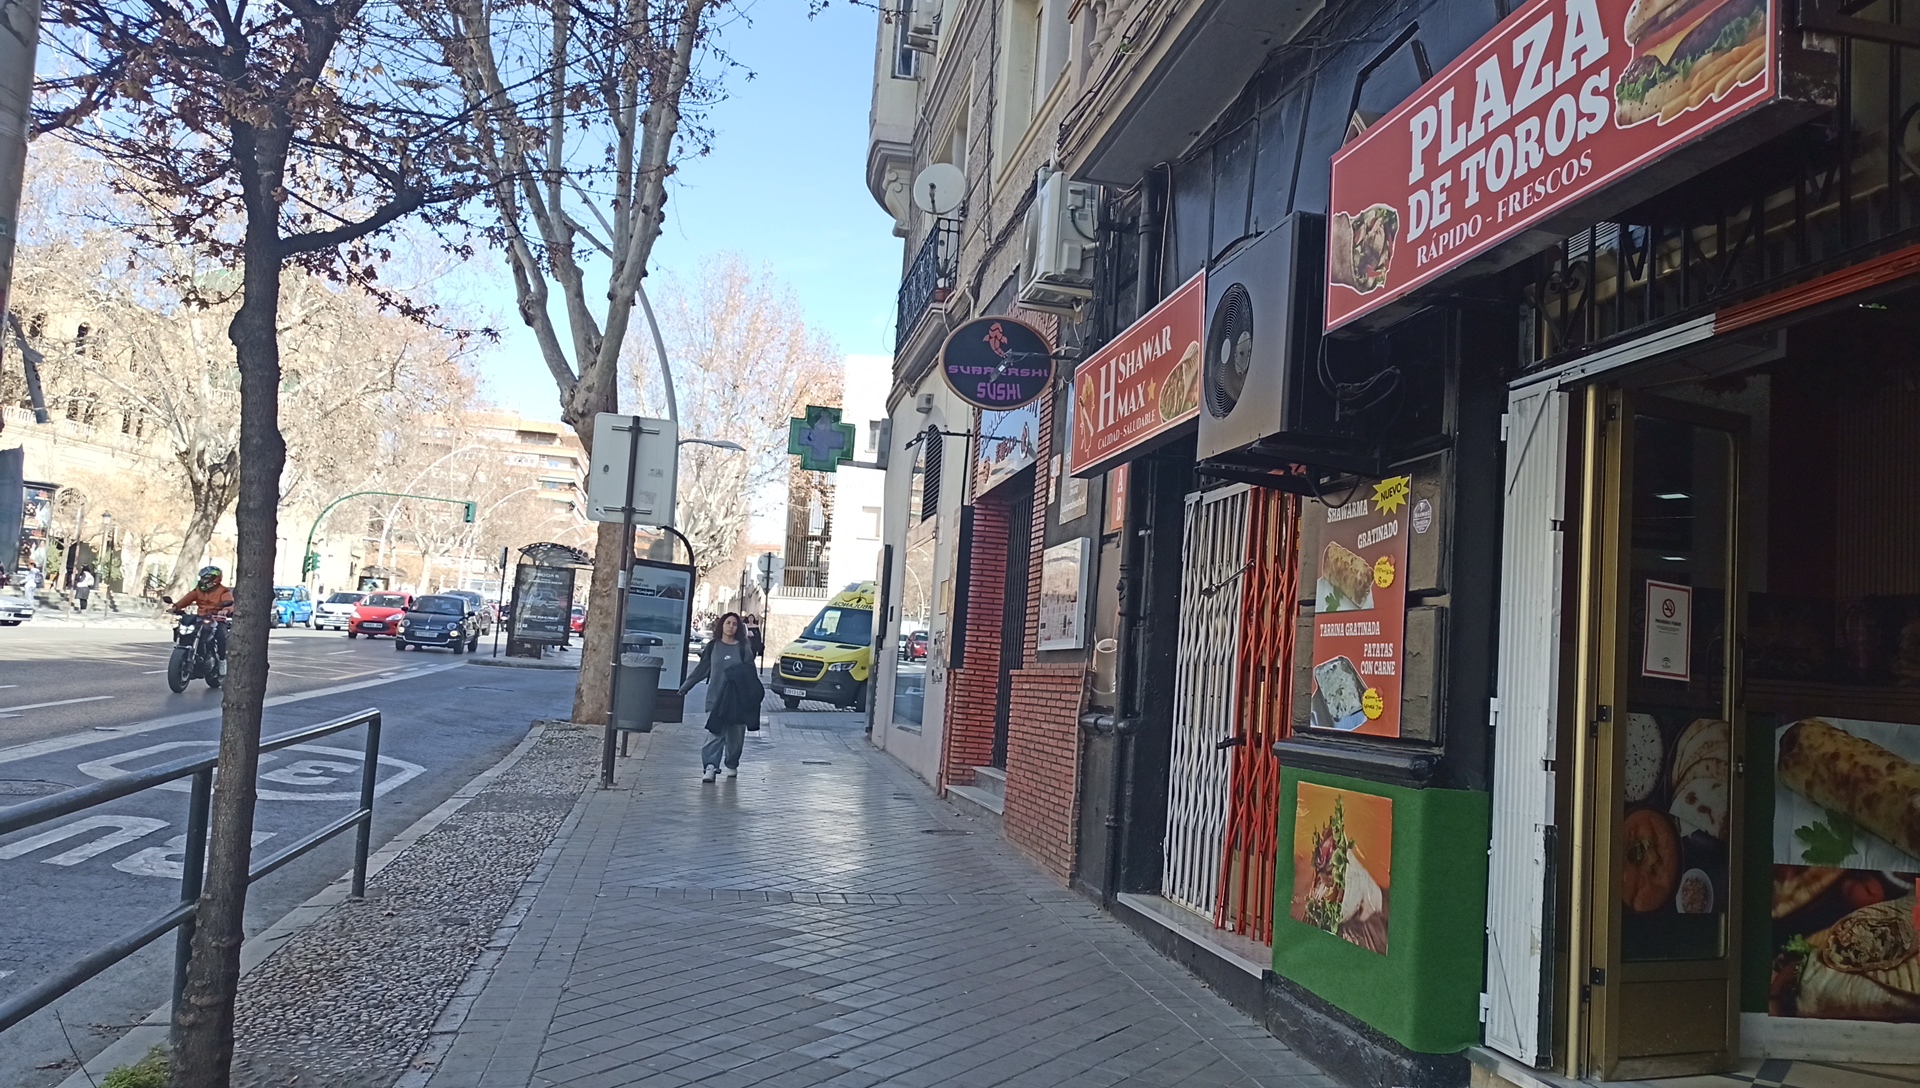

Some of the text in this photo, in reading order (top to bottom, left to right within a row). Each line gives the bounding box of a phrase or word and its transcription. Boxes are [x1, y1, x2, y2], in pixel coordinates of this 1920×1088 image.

[1408, 0, 1610, 186] PLAZA
[1406, 66, 1610, 244] DE TOROS
[1416, 213, 1483, 268] RÁPIDO
[1497, 149, 1593, 224] FRESCOS
[976, 381, 1022, 401] SUSHI
[1097, 325, 1172, 433] H SHAWAR
[1116, 380, 1147, 422] MAX
[1380, 482, 1402, 502] NUEVO
[1327, 499, 1369, 523] SHAWARMA
[1357, 519, 1399, 549] GRATINADO
[1320, 621, 1380, 637] TARRINA GRATINADA
[1363, 642, 1394, 658] PATATAS
[1360, 660, 1396, 676] CON CARNE
